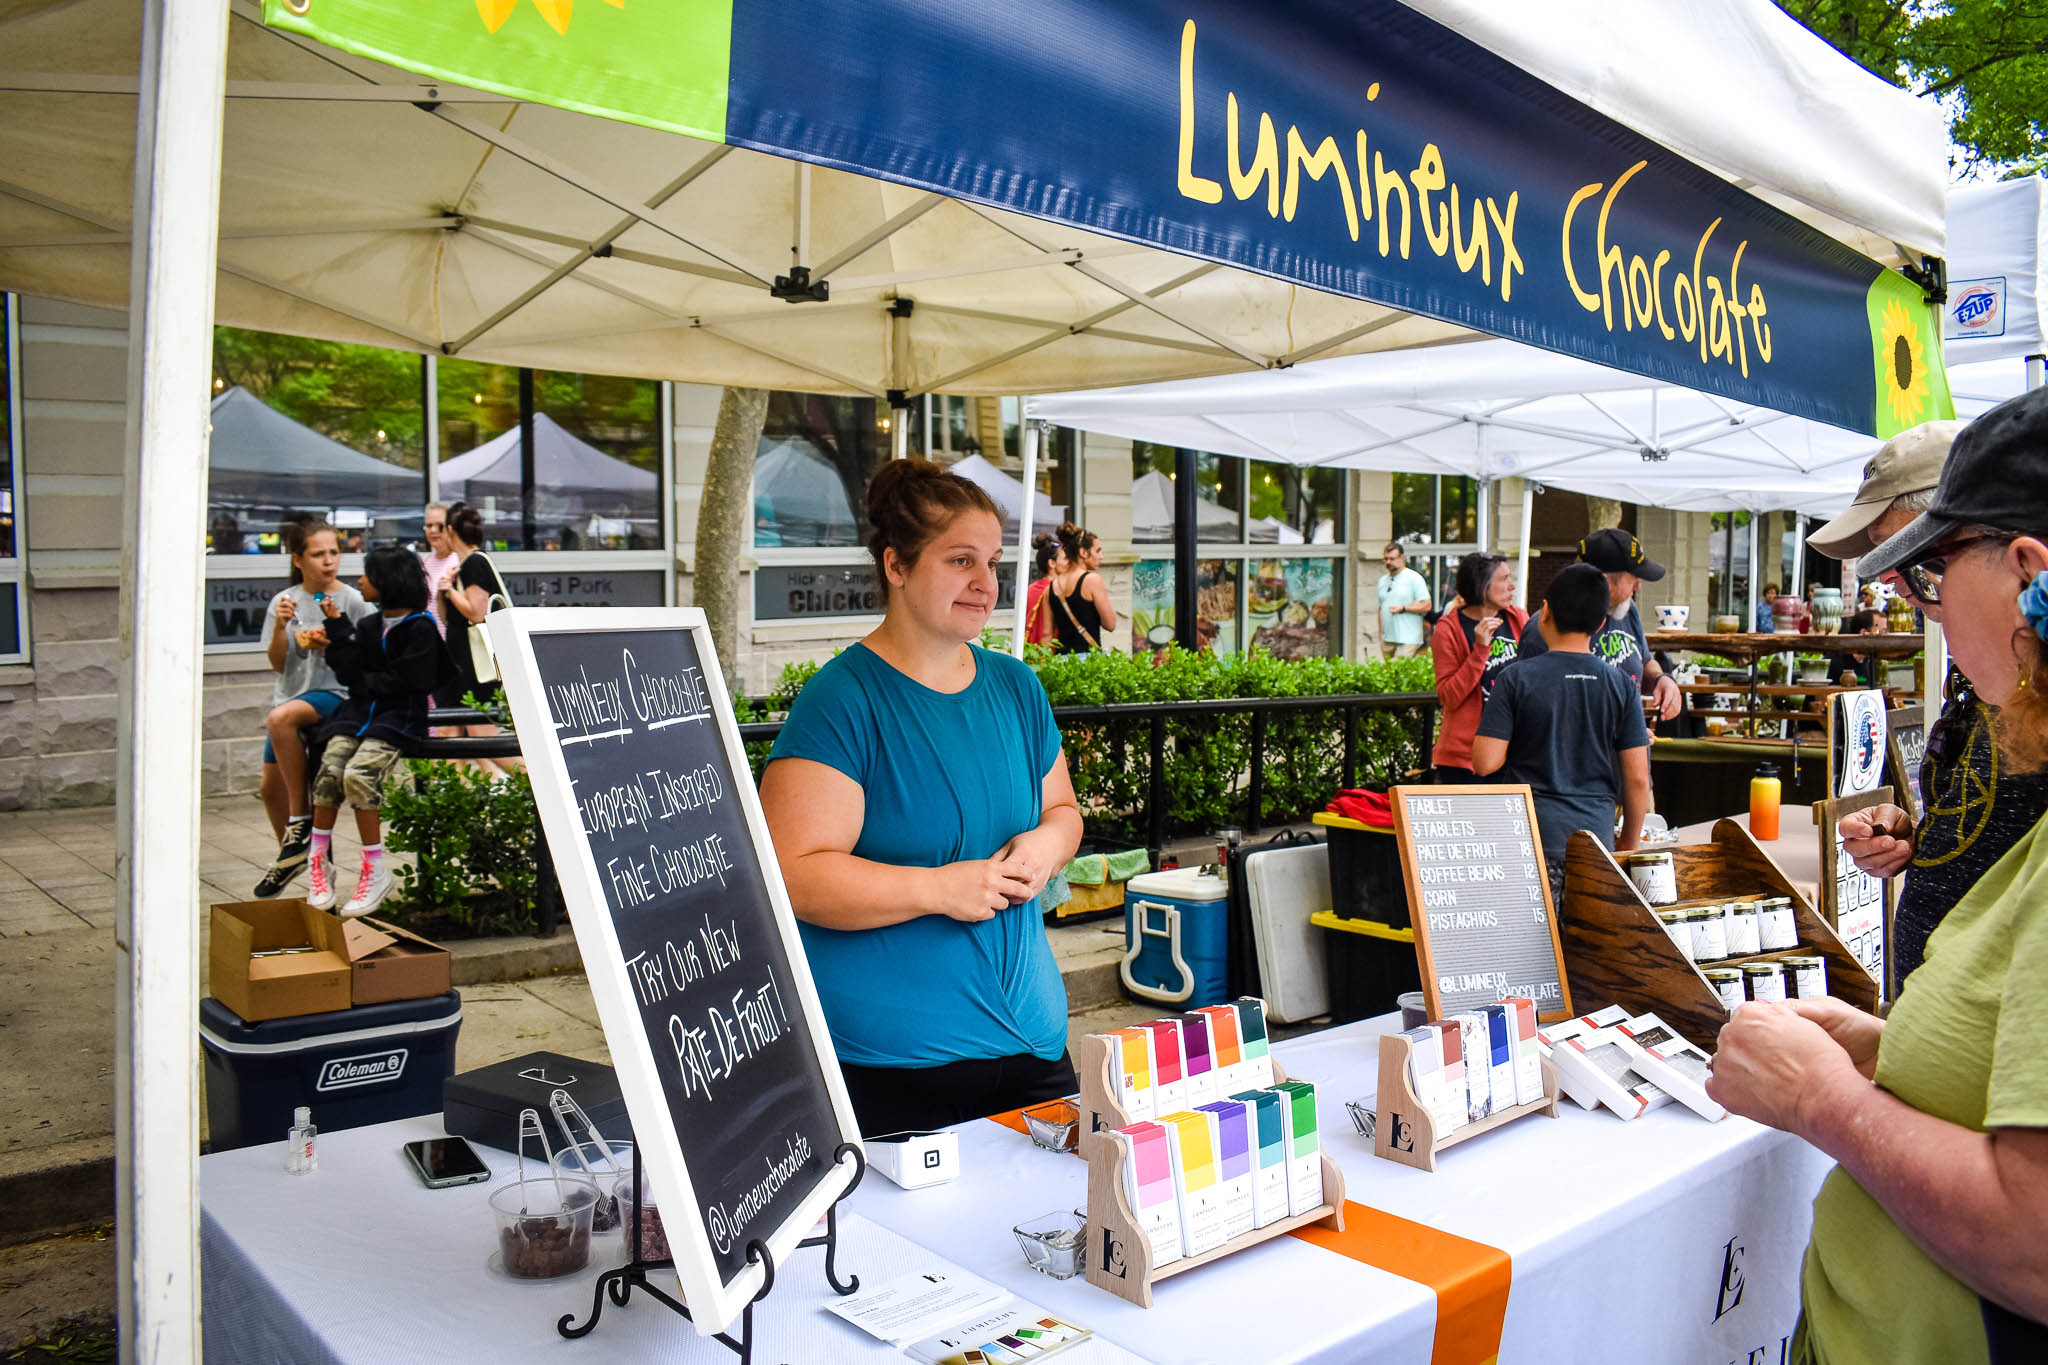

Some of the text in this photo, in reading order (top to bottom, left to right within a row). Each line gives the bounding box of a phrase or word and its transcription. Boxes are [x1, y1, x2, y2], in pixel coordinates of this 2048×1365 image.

[1177, 18, 1773, 379] Lumineux Chocolate
[213, 584, 273, 603] Hicko
[508, 576, 614, 596] ulld Pork
[788, 588, 877, 613] Chicke
[550, 648, 711, 747] UMINEUX CHOCOLATE
[1407, 798, 1453, 815] TABLET
[1421, 820, 1475, 838] TABLETS
[1513, 819, 1525, 836] 21
[1417, 841, 1532, 861] PATE DE FRUIT 18
[607, 833, 733, 909] FINE CHOCOLATE
[1420, 863, 1536, 884] COFFEE BEANS 12
[1424, 885, 1541, 907] CORN 12
[1429, 907, 1545, 931] PISTACHIOS 15
[625, 913, 741, 1006] TRY OUR NEW
[1439, 971, 1509, 994] @LUMINEUX
[709, 1007, 744, 1079] DE
[328, 1061, 386, 1081] Coleman
[708, 1132, 812, 1256] @lumineuxchocolate
